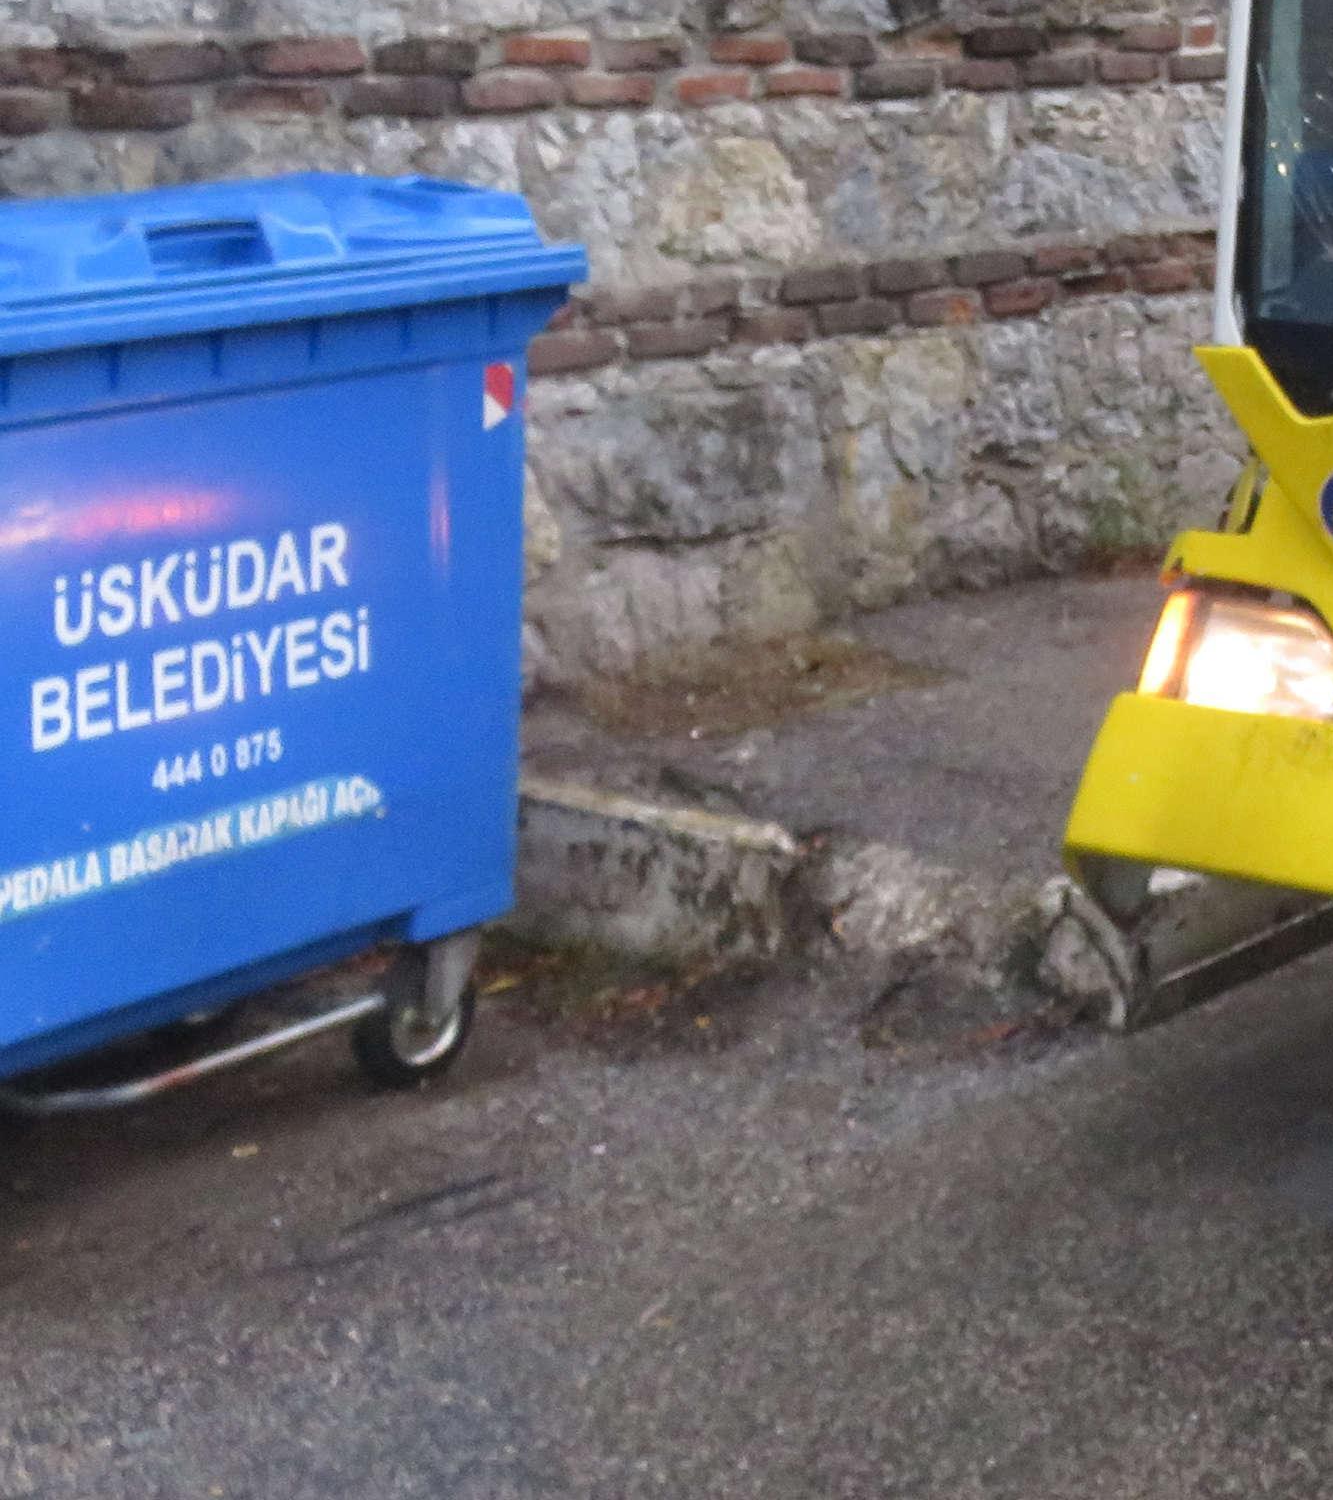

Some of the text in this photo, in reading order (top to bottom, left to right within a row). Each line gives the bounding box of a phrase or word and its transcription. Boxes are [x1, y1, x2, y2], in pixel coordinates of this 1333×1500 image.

[54, 521, 350, 647] ÜSKÜDAR
[31, 605, 370, 752] BELEDİYESİ
[151, 727, 284, 791] 444 0 875
